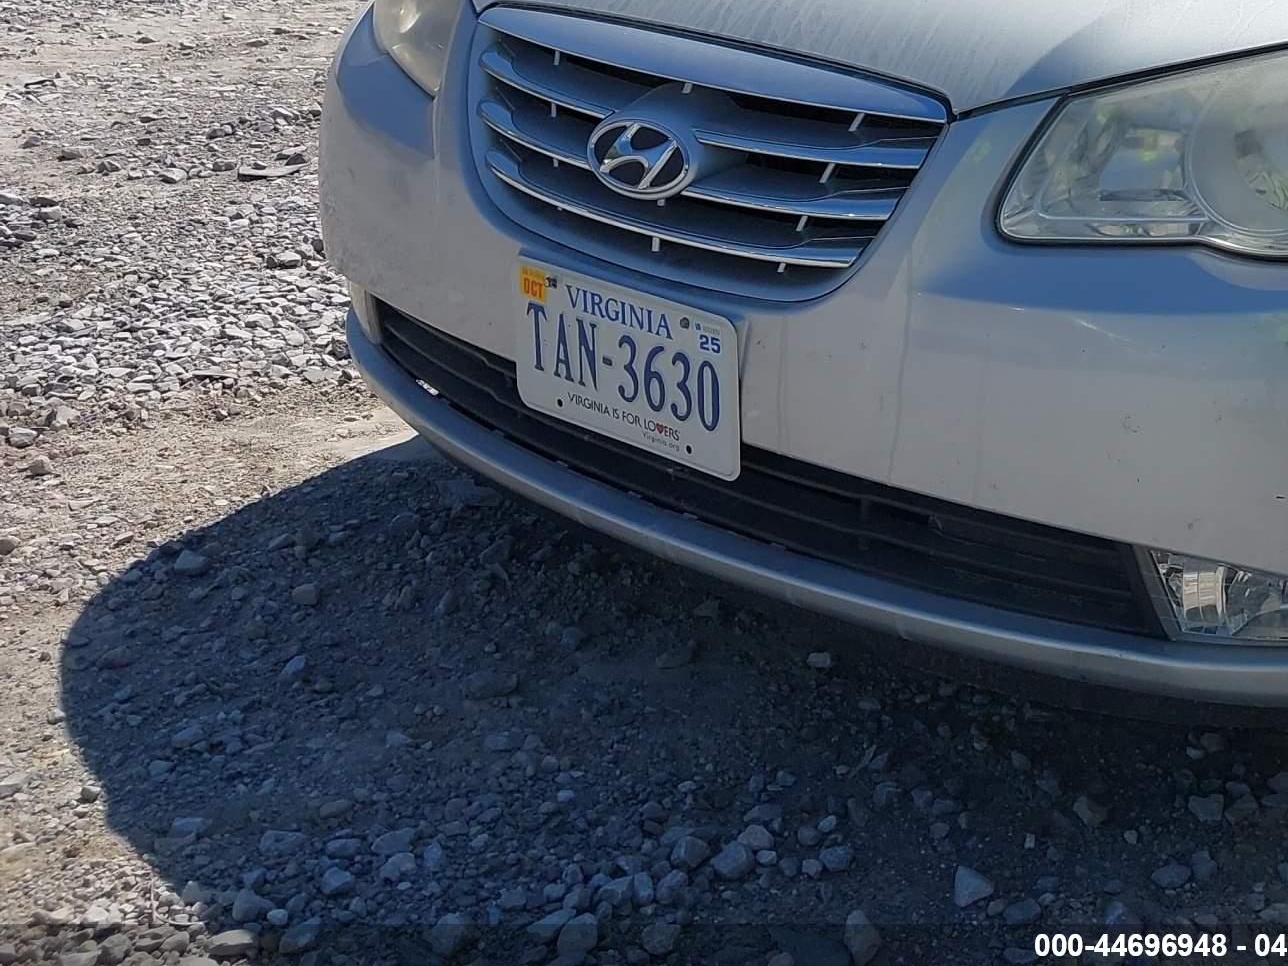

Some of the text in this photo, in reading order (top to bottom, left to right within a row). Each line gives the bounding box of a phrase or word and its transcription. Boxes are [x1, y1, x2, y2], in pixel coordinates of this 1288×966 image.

[523, 277, 543, 299] OCT
[565, 284, 673, 340] VIRGINIA
[699, 334, 721, 354] 25
[526, 300, 721, 433] TAN-3630
[567, 392, 611, 416] VIRGINIA
[612, 408, 620, 420] IS
[622, 411, 642, 428] FOR
